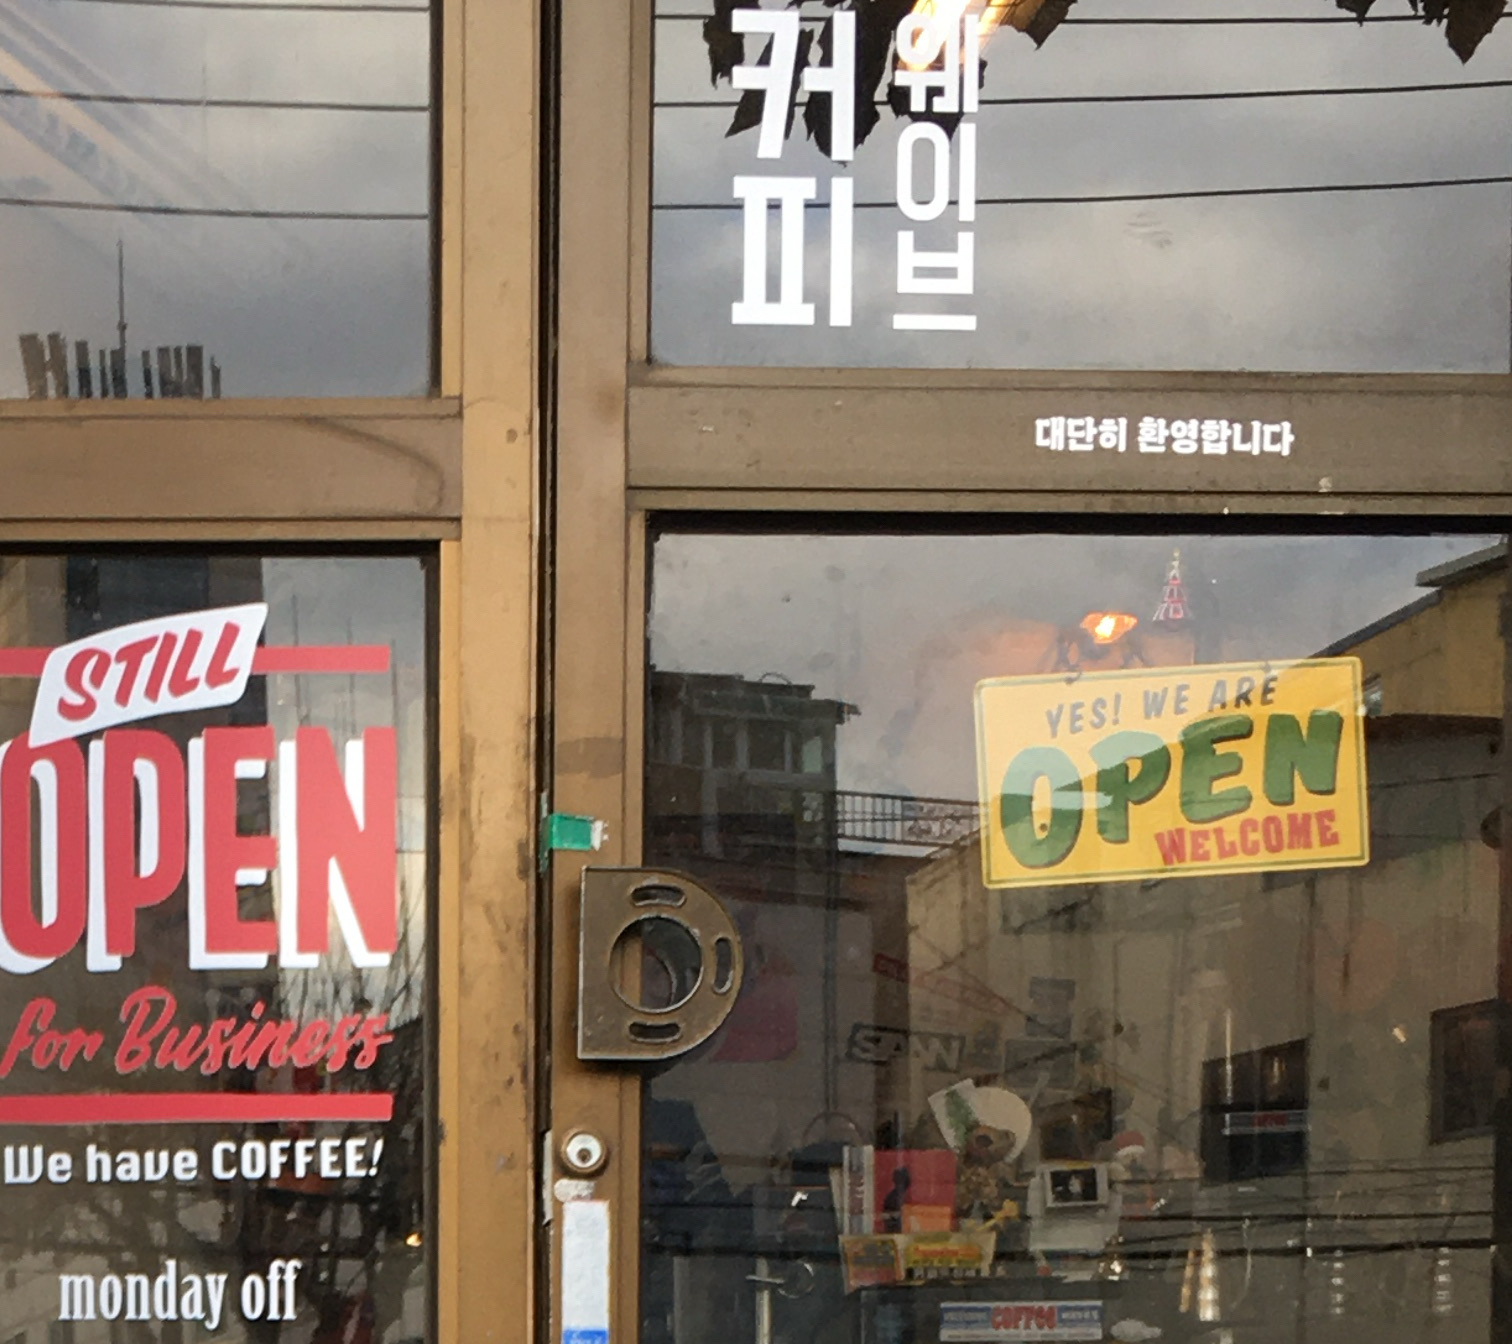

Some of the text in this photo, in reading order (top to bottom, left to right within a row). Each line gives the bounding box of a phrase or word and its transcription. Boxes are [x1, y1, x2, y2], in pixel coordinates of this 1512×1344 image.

[731, 9, 855, 326] 커피
[892, 13, 979, 330] 웨이브
[1035, 416, 1294, 457] 대단히 환영합니다
[57, 622, 241, 722] STILL
[1046, 675, 1278, 738] YES! WE ARE
[1000, 711, 1343, 869] OPEN
[1155, 809, 1340, 866] WELCOME
[115, 985, 394, 1075] Business
[4, 1138, 384, 1184] We have COFFEE!
[58, 1258, 303, 1330] monday off
